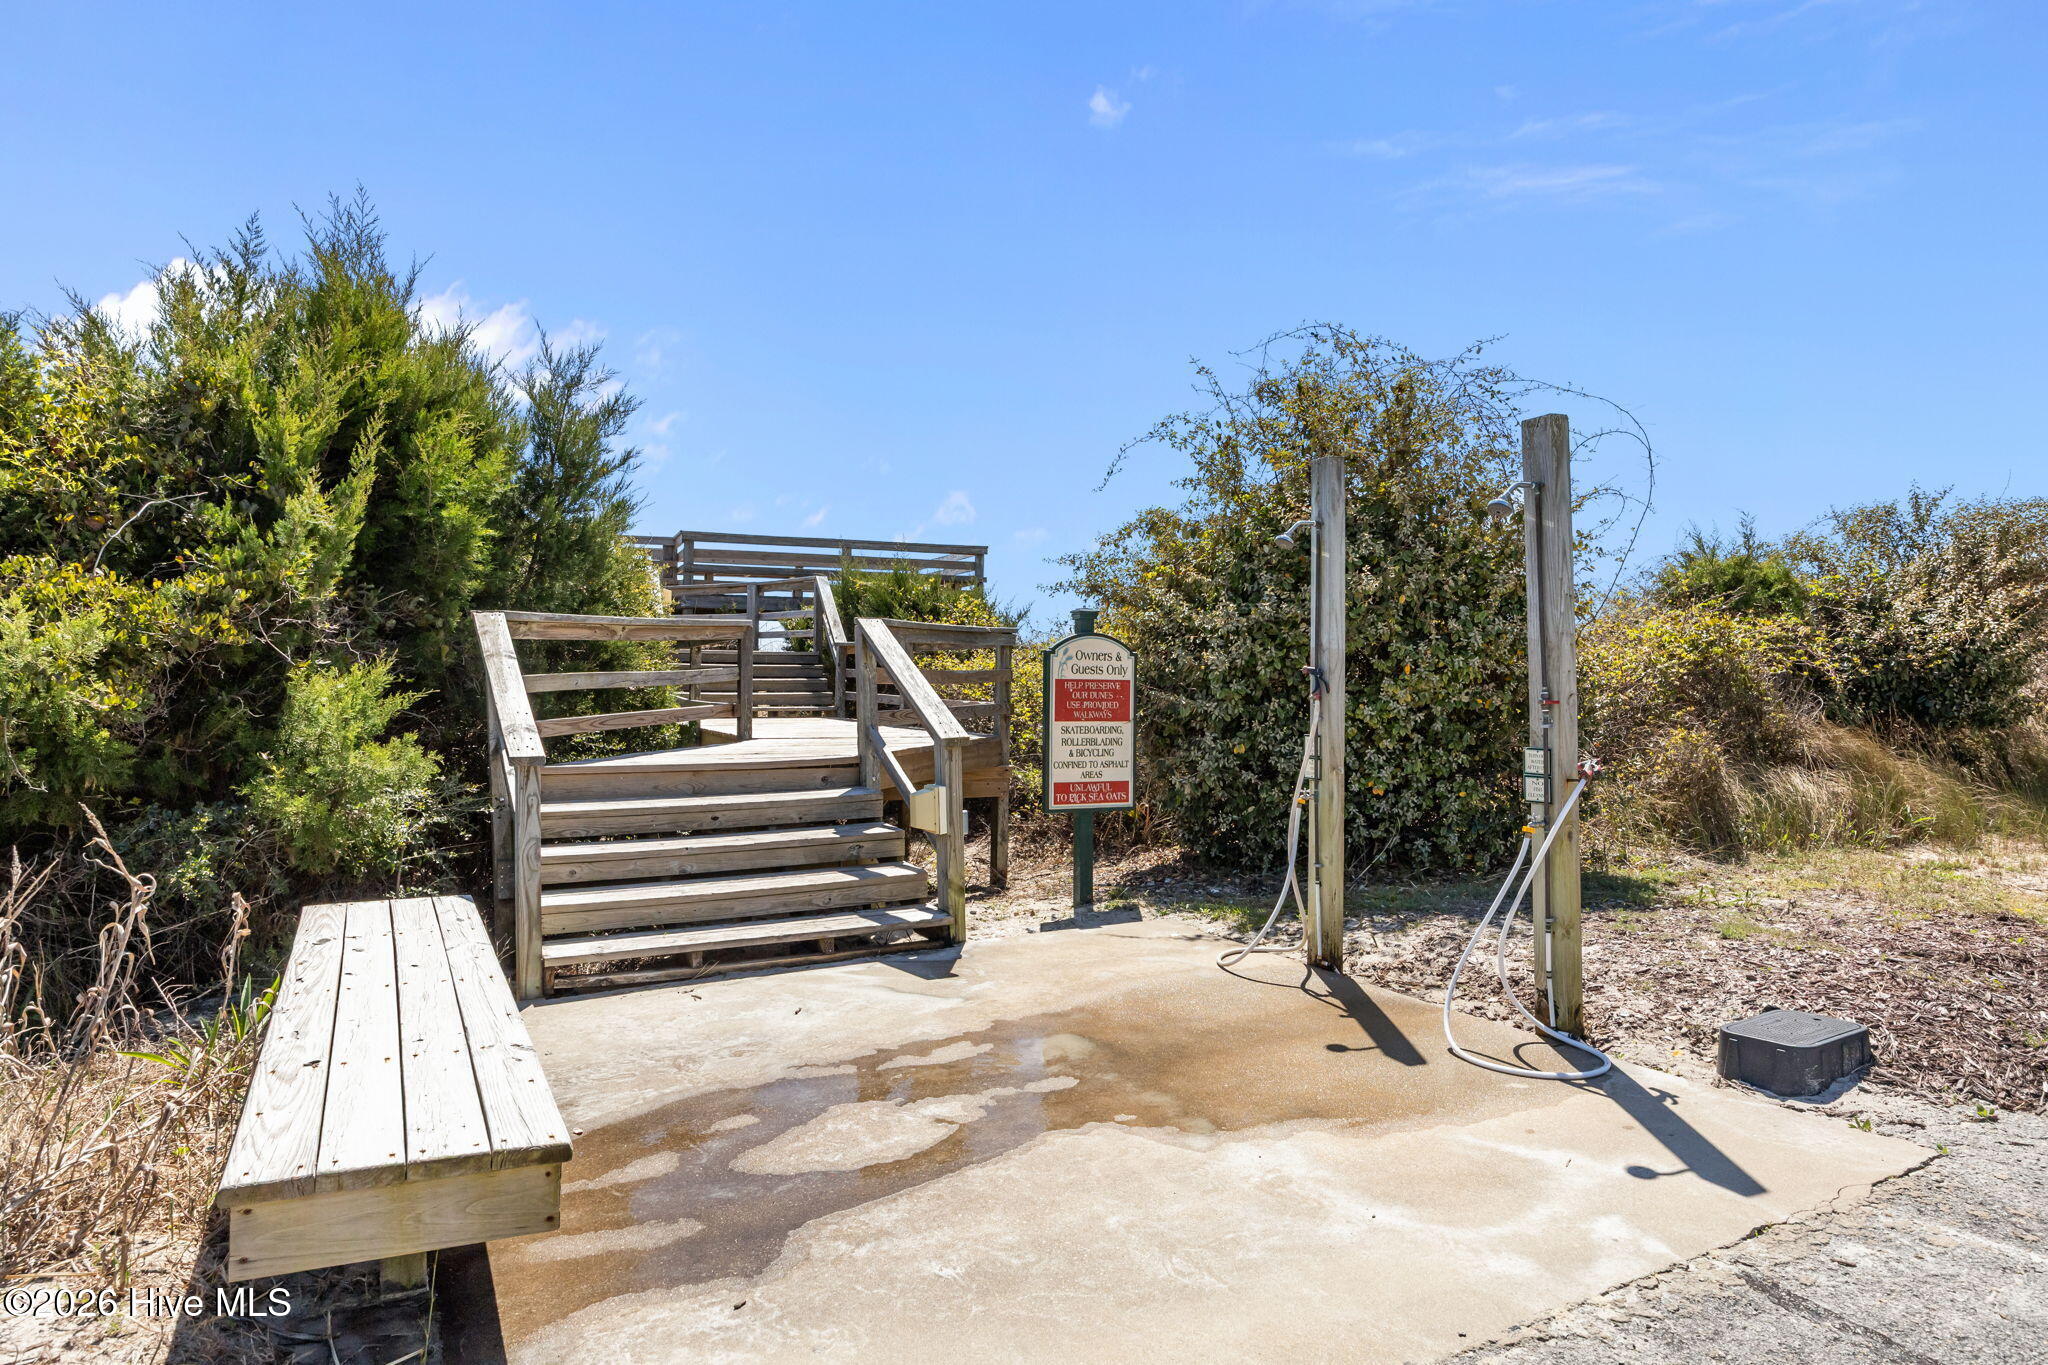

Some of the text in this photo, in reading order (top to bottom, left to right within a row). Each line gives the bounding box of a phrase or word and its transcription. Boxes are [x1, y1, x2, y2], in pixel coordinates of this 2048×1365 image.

[1076, 650, 1121, 661] Owners &
[1071, 664, 1128, 677] Guests Only
[1065, 682, 1121, 690] HELP PRESERVE
[1061, 738, 1122, 746] ROLLERBLADING
[1076, 749, 1114, 757] BICYCLING
[1053, 761, 1087, 769] CONFINED
[1100, 760, 1128, 768] ASPHALT
[1070, 783, 1112, 791] UNLAWFUL
[1069, 793, 1086, 802] PICK
[1106, 792, 1126, 800] OATS
